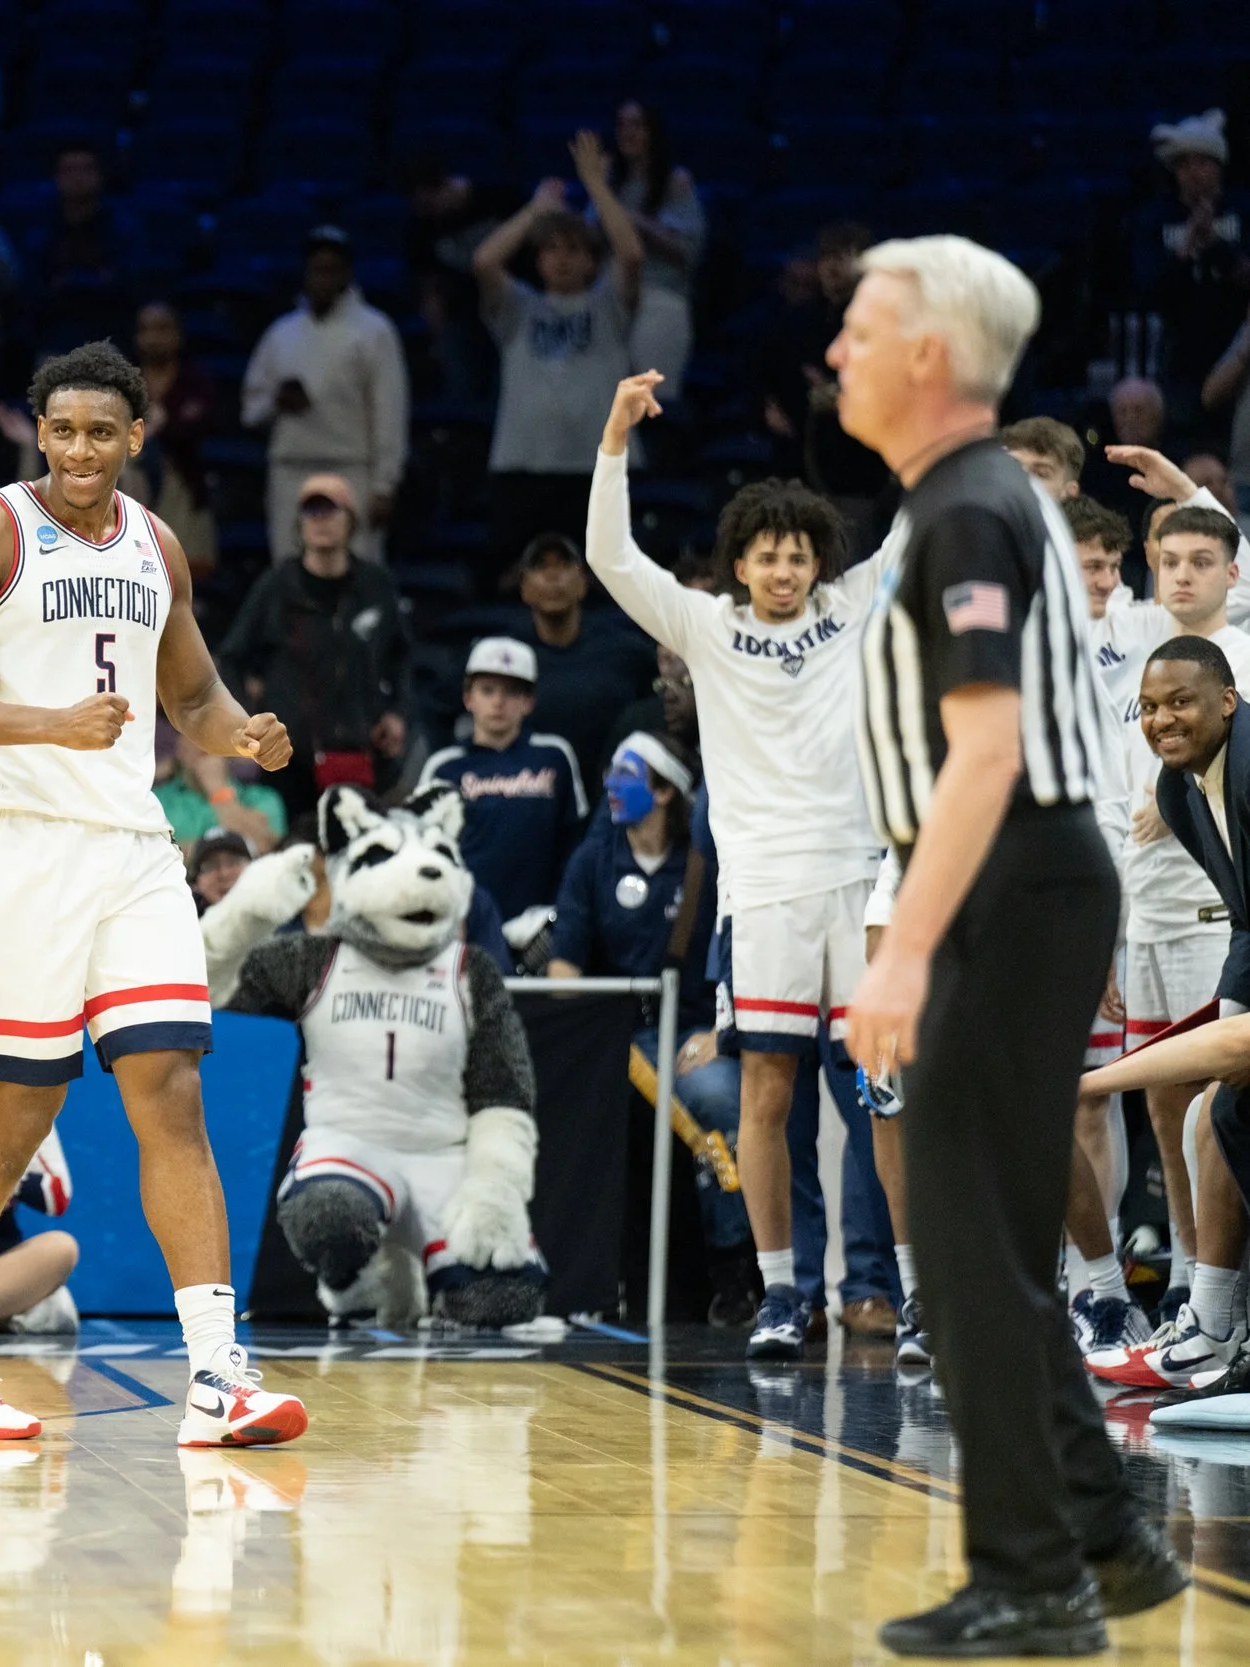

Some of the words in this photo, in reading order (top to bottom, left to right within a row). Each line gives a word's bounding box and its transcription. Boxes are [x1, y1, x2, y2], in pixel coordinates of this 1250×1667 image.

[42, 576, 158, 631] CONNECTICUT
[95, 632, 116, 693] 5
[331, 991, 446, 1035] CONNECTICUT
[385, 1031, 395, 1081] 1
